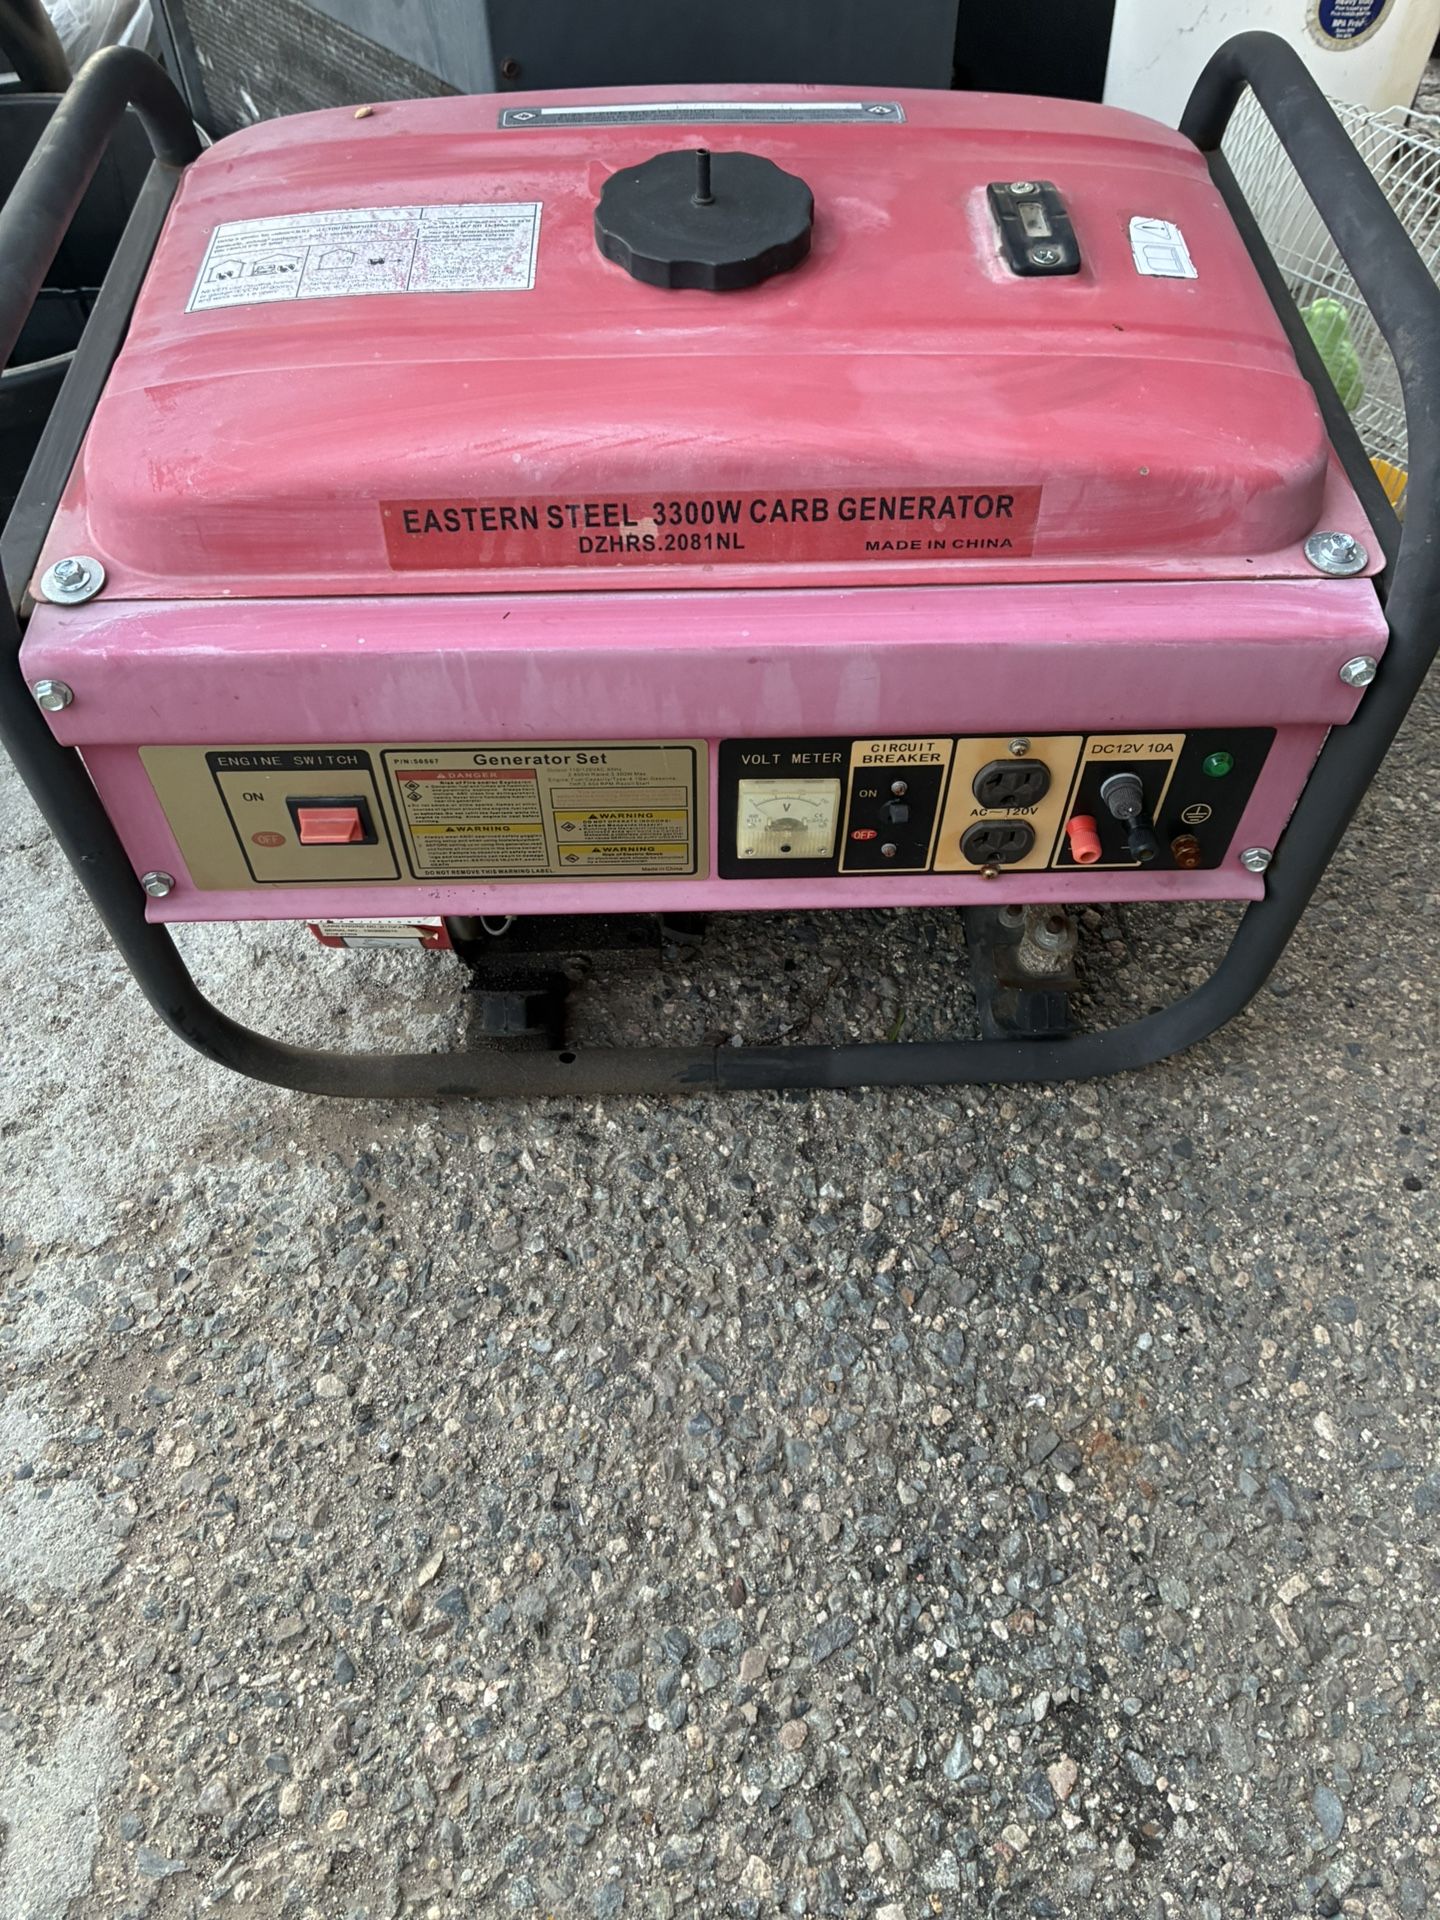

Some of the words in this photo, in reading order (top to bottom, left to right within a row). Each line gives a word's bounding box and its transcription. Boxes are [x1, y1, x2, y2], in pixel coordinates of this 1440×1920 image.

[402, 506, 539, 534] EASTERN
[547, 503, 639, 529] STEEL
[652, 499, 742, 526] 3300W
[750, 498, 829, 524] CARB
[837, 494, 1015, 522] GENERATOR
[579, 532, 745, 554] DZHRS.2081NL
[865, 540, 922, 551] MADE
[928, 539, 946, 550] IN
[952, 538, 1013, 549] CHINA
[871, 742, 935, 753] CIRCUIT
[1091, 744, 1145, 754] DC12V
[1147, 743, 1174, 753] 10A
[217, 755, 283, 767] ENGINE
[293, 755, 358, 766] SWITCH
[473, 753, 571, 766] Generator
[576, 752, 607, 765] Set
[741, 754, 781, 765] VOLT
[791, 752, 842, 764] METER
[862, 752, 941, 764] BREAKER
[242, 792, 265, 802] ON
[858, 789, 877, 798] ON
[783, 803, 791, 812] V
[258, 834, 280, 844] OFF
[853, 830, 875, 839] OFF
